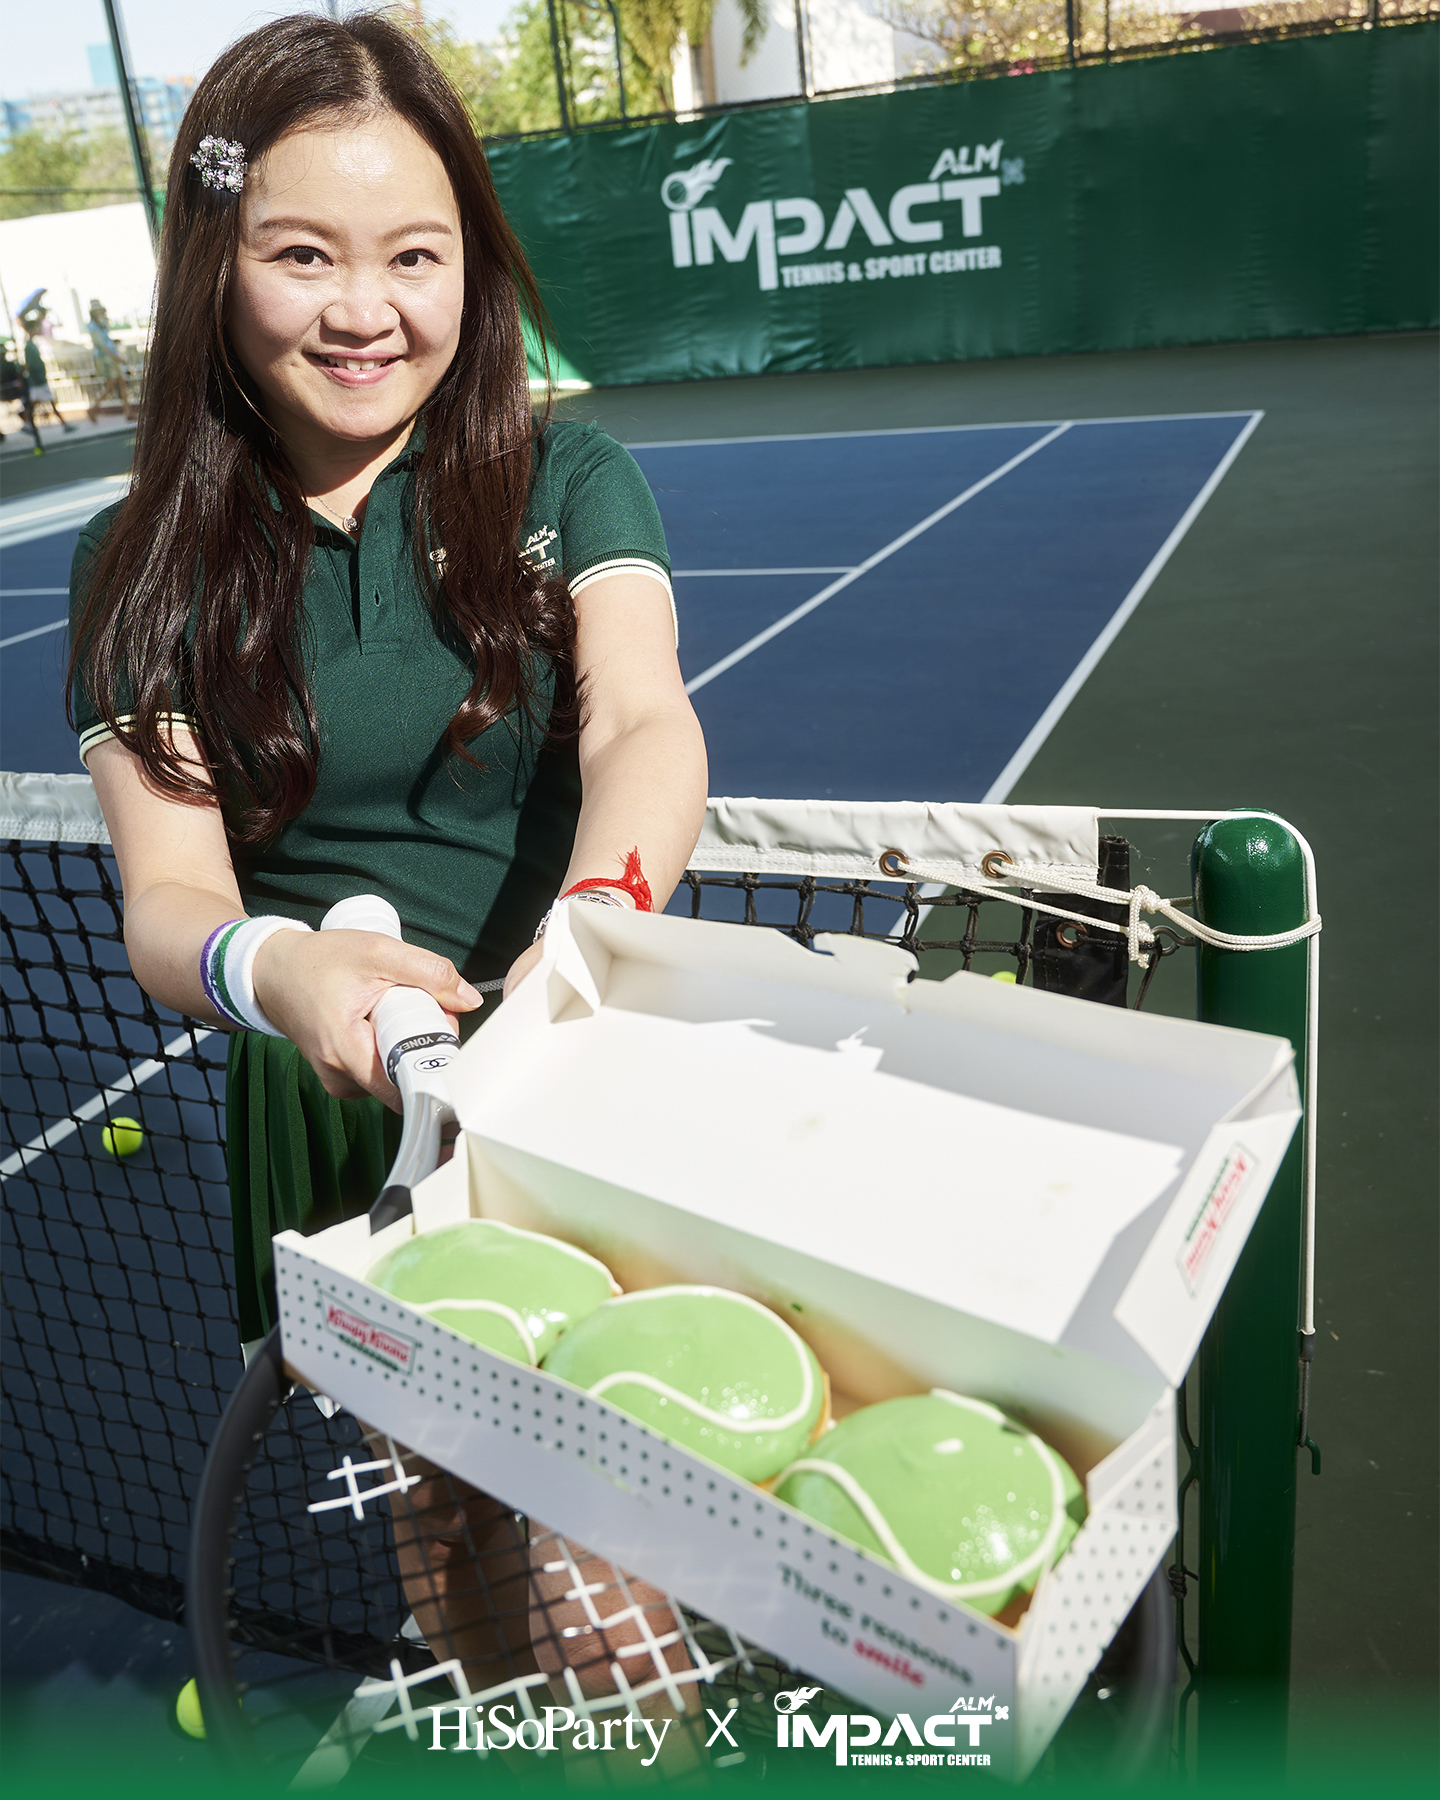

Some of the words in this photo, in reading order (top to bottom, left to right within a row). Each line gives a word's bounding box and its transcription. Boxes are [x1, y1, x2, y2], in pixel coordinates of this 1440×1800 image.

[928, 139, 1004, 182] ALM
[669, 176, 1001, 291] IMPACT
[780, 261, 846, 288] TENNIS
[847, 262, 864, 282] &
[864, 253, 928, 281] SPORT
[929, 245, 1002, 275] CENTER
[395, 1035, 434, 1055] YONEX
[779, 1562, 852, 1619] Three
[860, 1613, 974, 1688] reasons
[820, 1616, 849, 1647] to
[854, 1638, 926, 1687] smile
